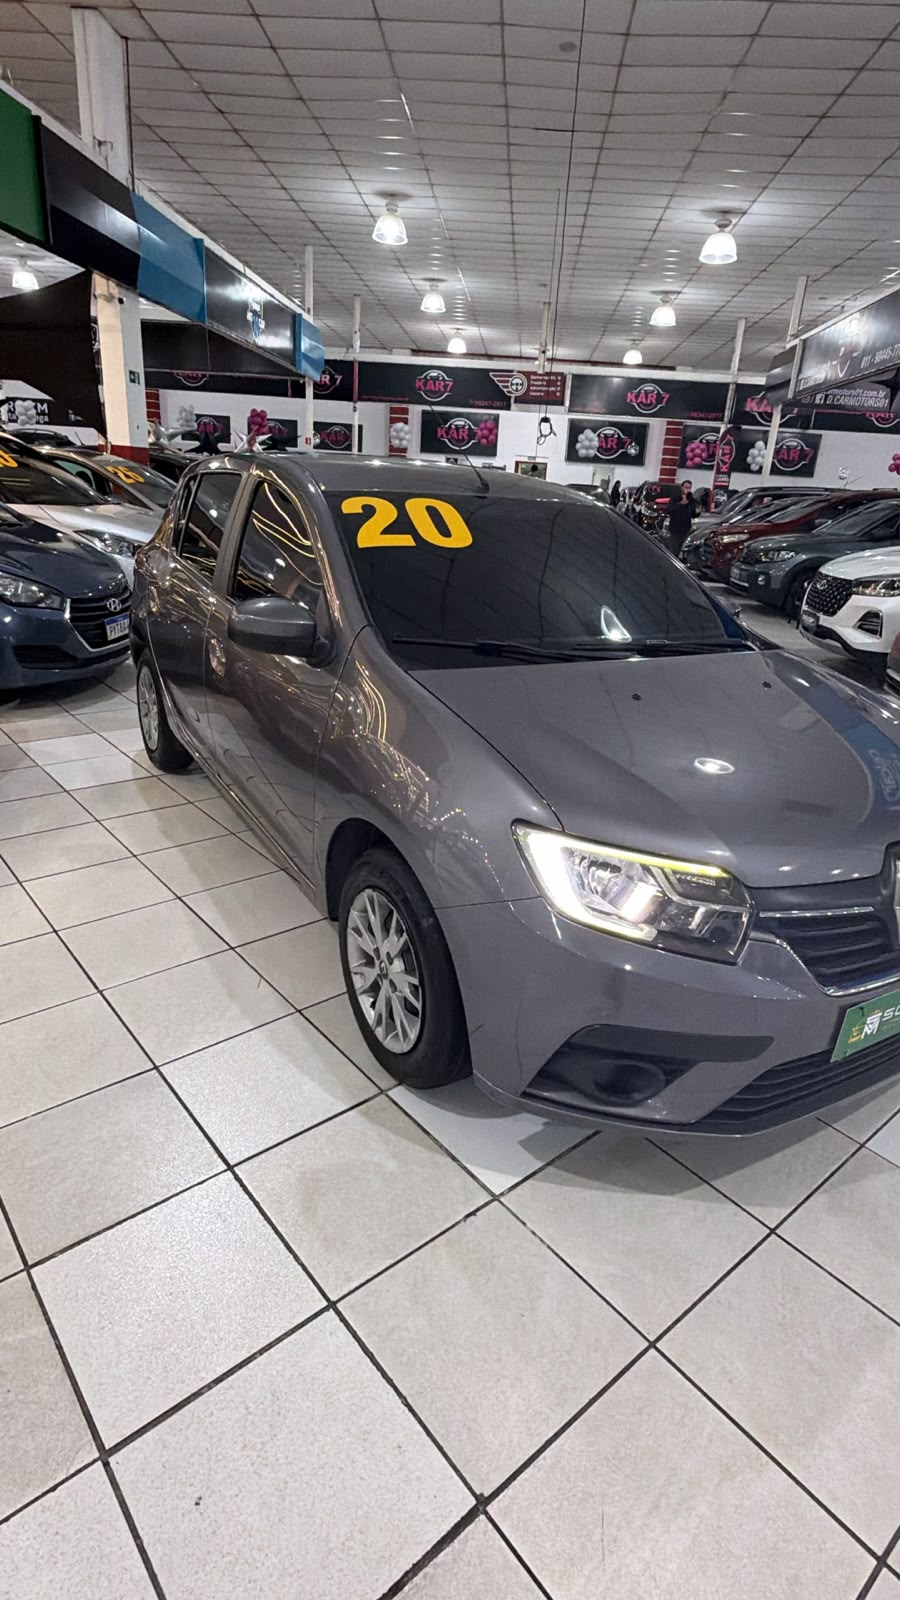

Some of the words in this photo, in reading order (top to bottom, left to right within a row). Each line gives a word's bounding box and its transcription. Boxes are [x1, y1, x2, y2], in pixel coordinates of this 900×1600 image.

[626, 391, 657, 404] KAR
[661, 394, 670, 405] 7
[745, 397, 773, 413] KA
[437, 427, 469, 440] KAR
[598, 437, 618, 449] AR
[341, 496, 473, 548] 20
